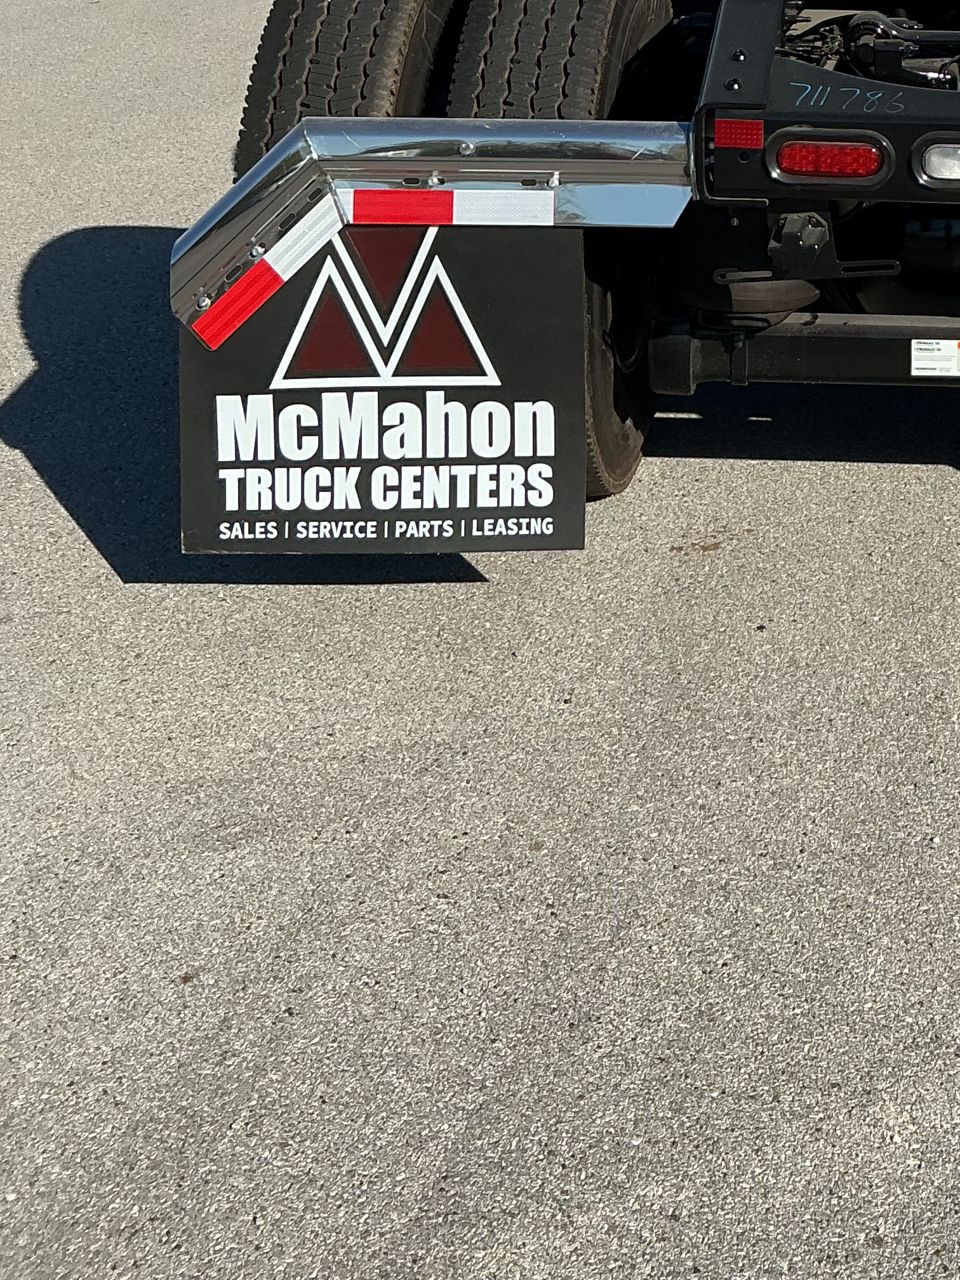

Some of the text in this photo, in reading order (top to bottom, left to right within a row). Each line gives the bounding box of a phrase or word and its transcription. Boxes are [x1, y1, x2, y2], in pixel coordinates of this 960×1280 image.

[215, 391, 555, 462] McMahon
[218, 462, 554, 512] TRUCK CENTERS
[218, 516, 554, 540] SALES SERVICE PARTS LEASING
